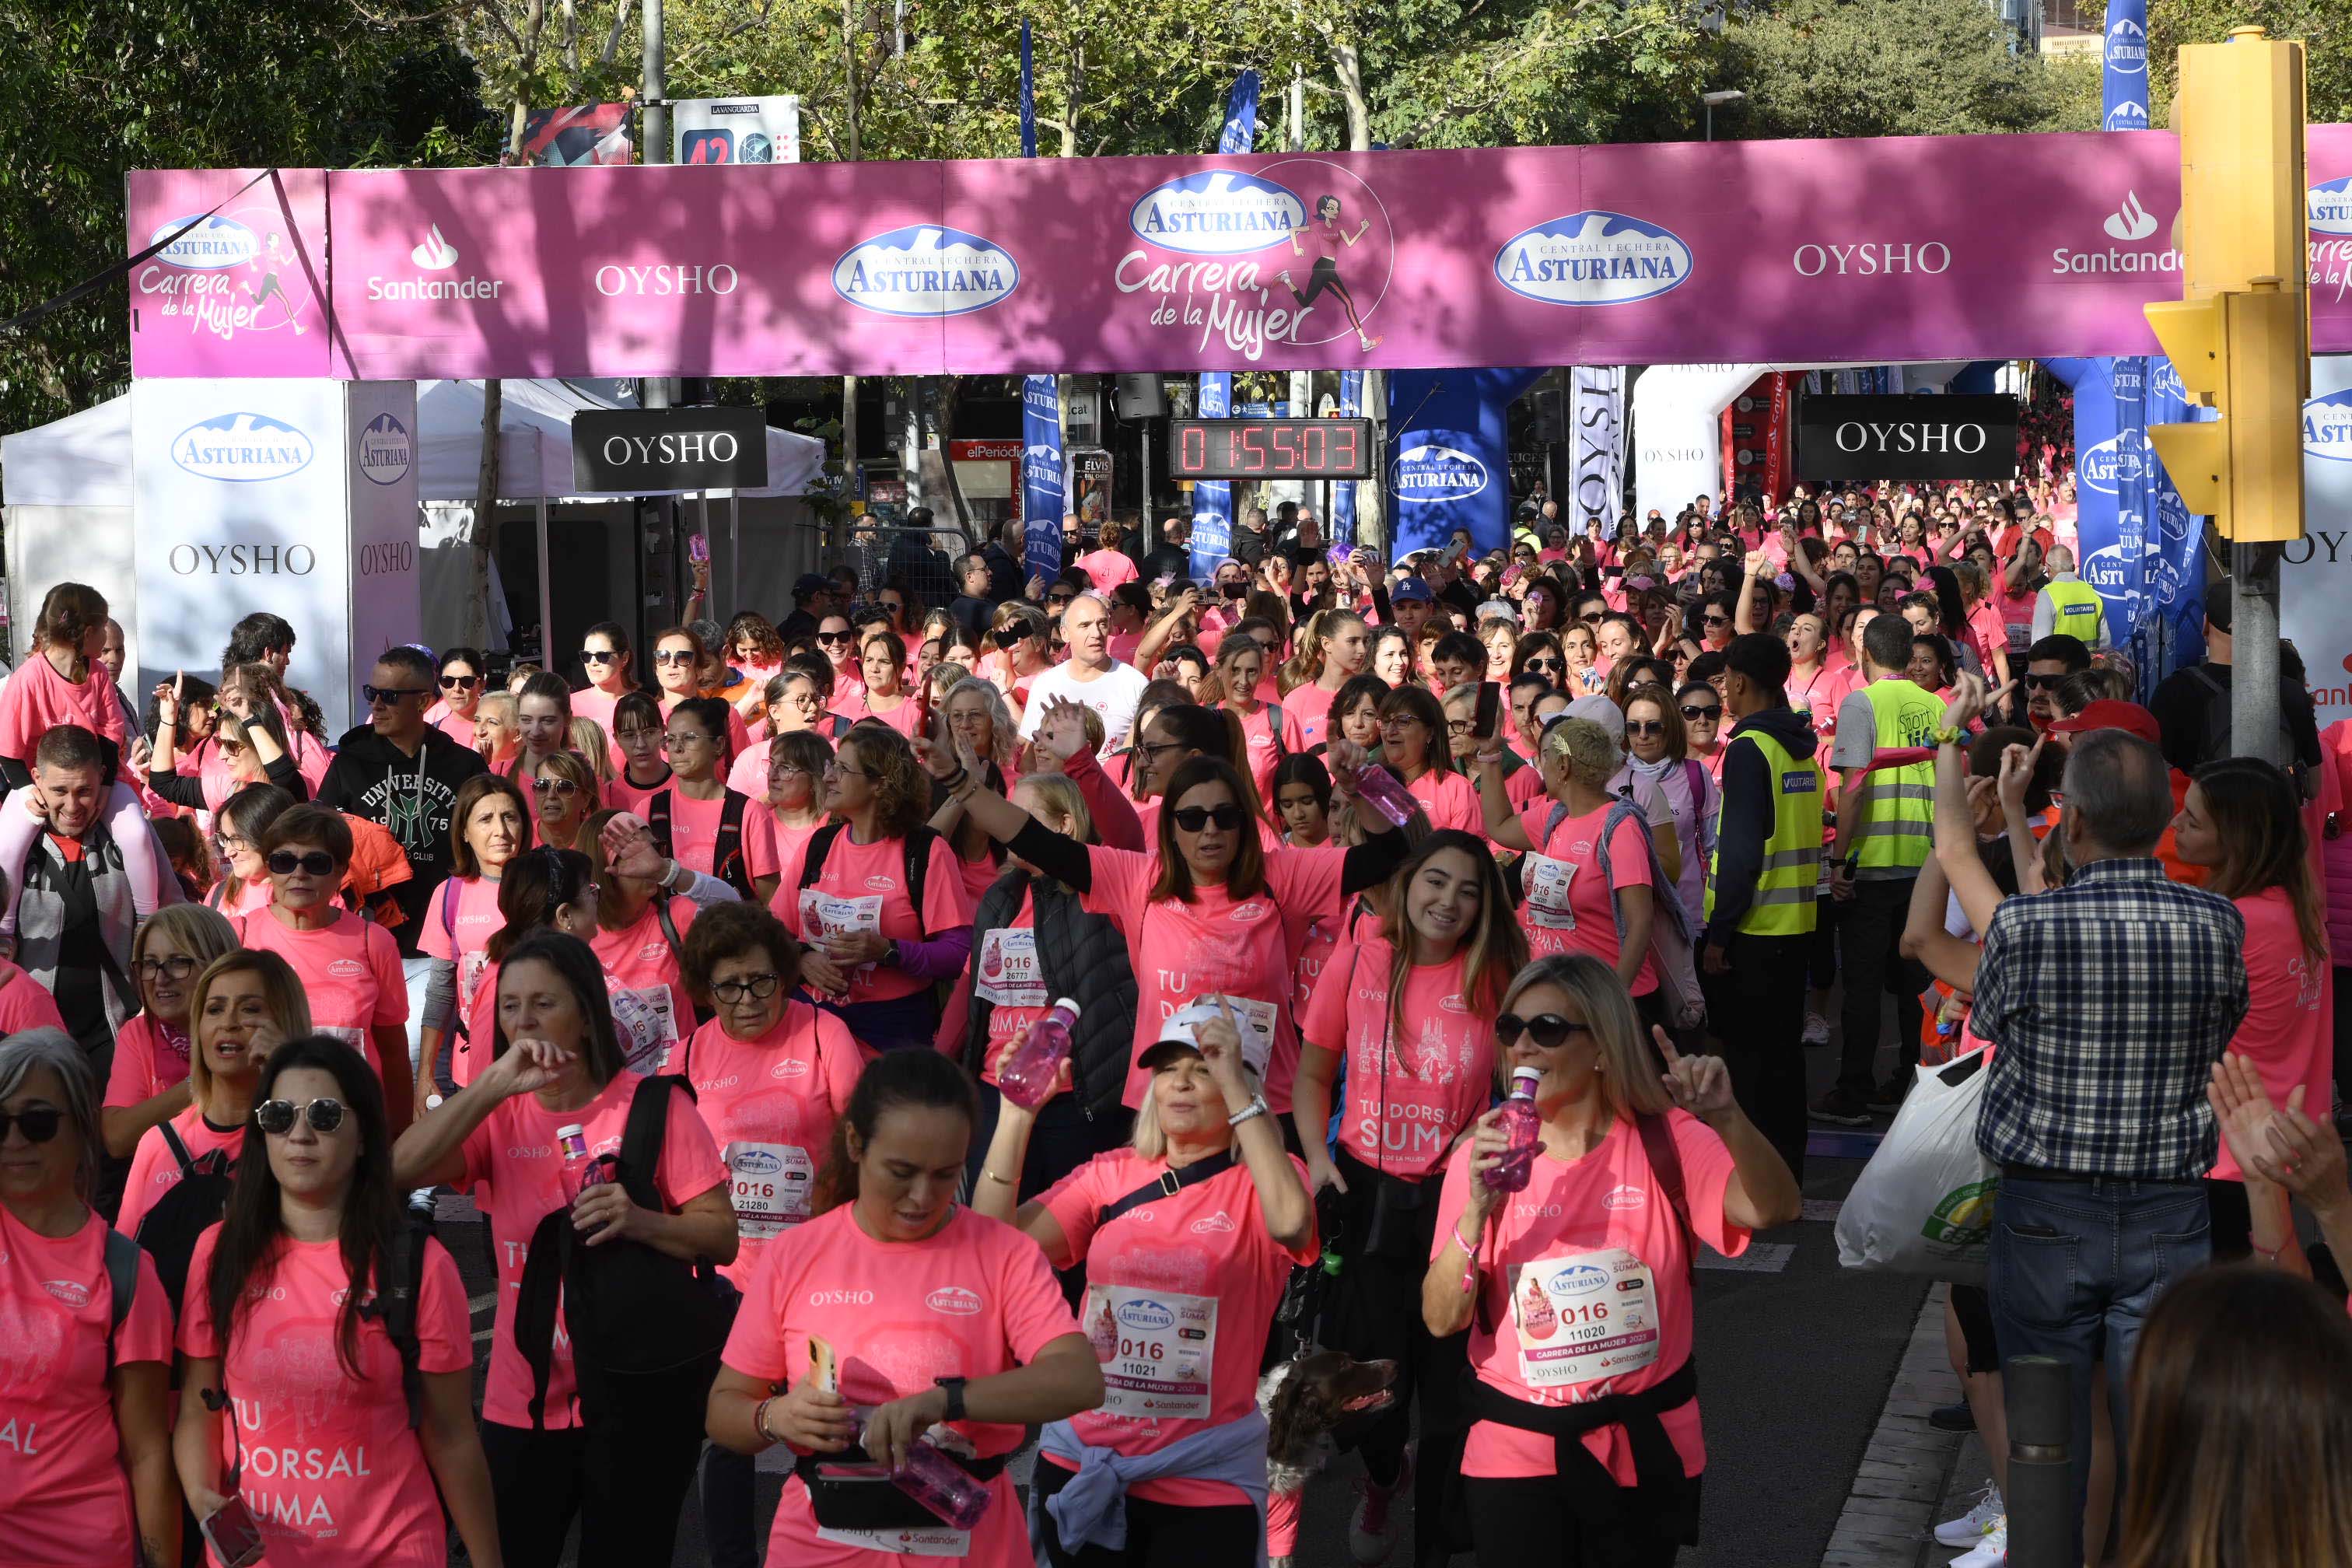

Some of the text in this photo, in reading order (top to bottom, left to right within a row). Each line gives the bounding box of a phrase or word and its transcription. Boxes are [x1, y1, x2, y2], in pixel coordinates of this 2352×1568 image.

[1171, 198, 1288, 208] CENTRAL LECHERA
[1143, 201, 1292, 233] ASTURIANA
[1540, 243, 1671, 254] CENTRAL LECHERA
[1793, 242, 1951, 276] OYSHO
[2308, 240, 2352, 262] arre
[940, 256, 999, 264] LECHERA
[1510, 247, 1677, 282] ASTURIANA
[2053, 248, 2183, 274] Santand
[139, 265, 230, 294] Carrera
[595, 264, 738, 296] OYSHO
[846, 259, 1004, 293] ASTURIANA
[1115, 250, 1261, 293] Carrera
[2325, 263, 2340, 285] la
[368, 276, 503, 300] Santander
[162, 292, 265, 340] de la Mujer
[1150, 288, 1315, 361] de la Mujer
[1836, 422, 1986, 453] OYSHO
[183, 438, 303, 464] ASTURIANA
[362, 440, 408, 467] ASTURIANA
[604, 432, 738, 465] OYSHO
[1183, 428, 1356, 471] 01:55:03
[1645, 448, 1704, 462] OYSHO
[1085, 460, 1108, 471] ELVIS
[1392, 468, 1480, 490] ASTURIANA
[169, 544, 316, 575] OYSHO
[360, 541, 411, 576] OYSHO
[1899, 709, 1933, 735] Sport
[430, 817, 449, 831] 75
[414, 852, 434, 861] CLUB
[1534, 883, 1550, 896] 016
[457, 914, 491, 925] OYSHO
[1004, 957, 1031, 969] 016
[1157, 969, 1186, 993] TU
[1360, 1099, 1458, 1125] TU DORSL
[1360, 1118, 1453, 1152] SUM
[786, 1157, 807, 1166] SUMA
[737, 1181, 774, 1198] 016
[739, 1200, 769, 1211] 21280
[1612, 1262, 1640, 1273] SUMA
[1555, 1276, 1605, 1292] ASTURIANA
[810, 1290, 873, 1307] OYSHO
[932, 1296, 978, 1310] ASTURIANA
[1121, 1312, 1169, 1325] ASTURIANA
[1181, 1312, 1206, 1321] SUMA
[1561, 1302, 1608, 1326] 016
[1570, 1325, 1605, 1341] 11020
[1121, 1339, 1164, 1360] 016
[1536, 1334, 1647, 1360] CARRERA DE LA MUJER 2023
[1612, 1349, 1650, 1366] Santander
[1122, 1363, 1156, 1376] 11021
[1537, 1364, 1577, 1379] OYSHO
[1123, 1380, 1134, 1388] DE
[1136, 1381, 1146, 1389] LA
[1147, 1382, 1175, 1392] MUJER
[1155, 1401, 1200, 1410] Santander
[317, 1529, 338, 1538] 2023
[912, 1535, 960, 1545] Santander
